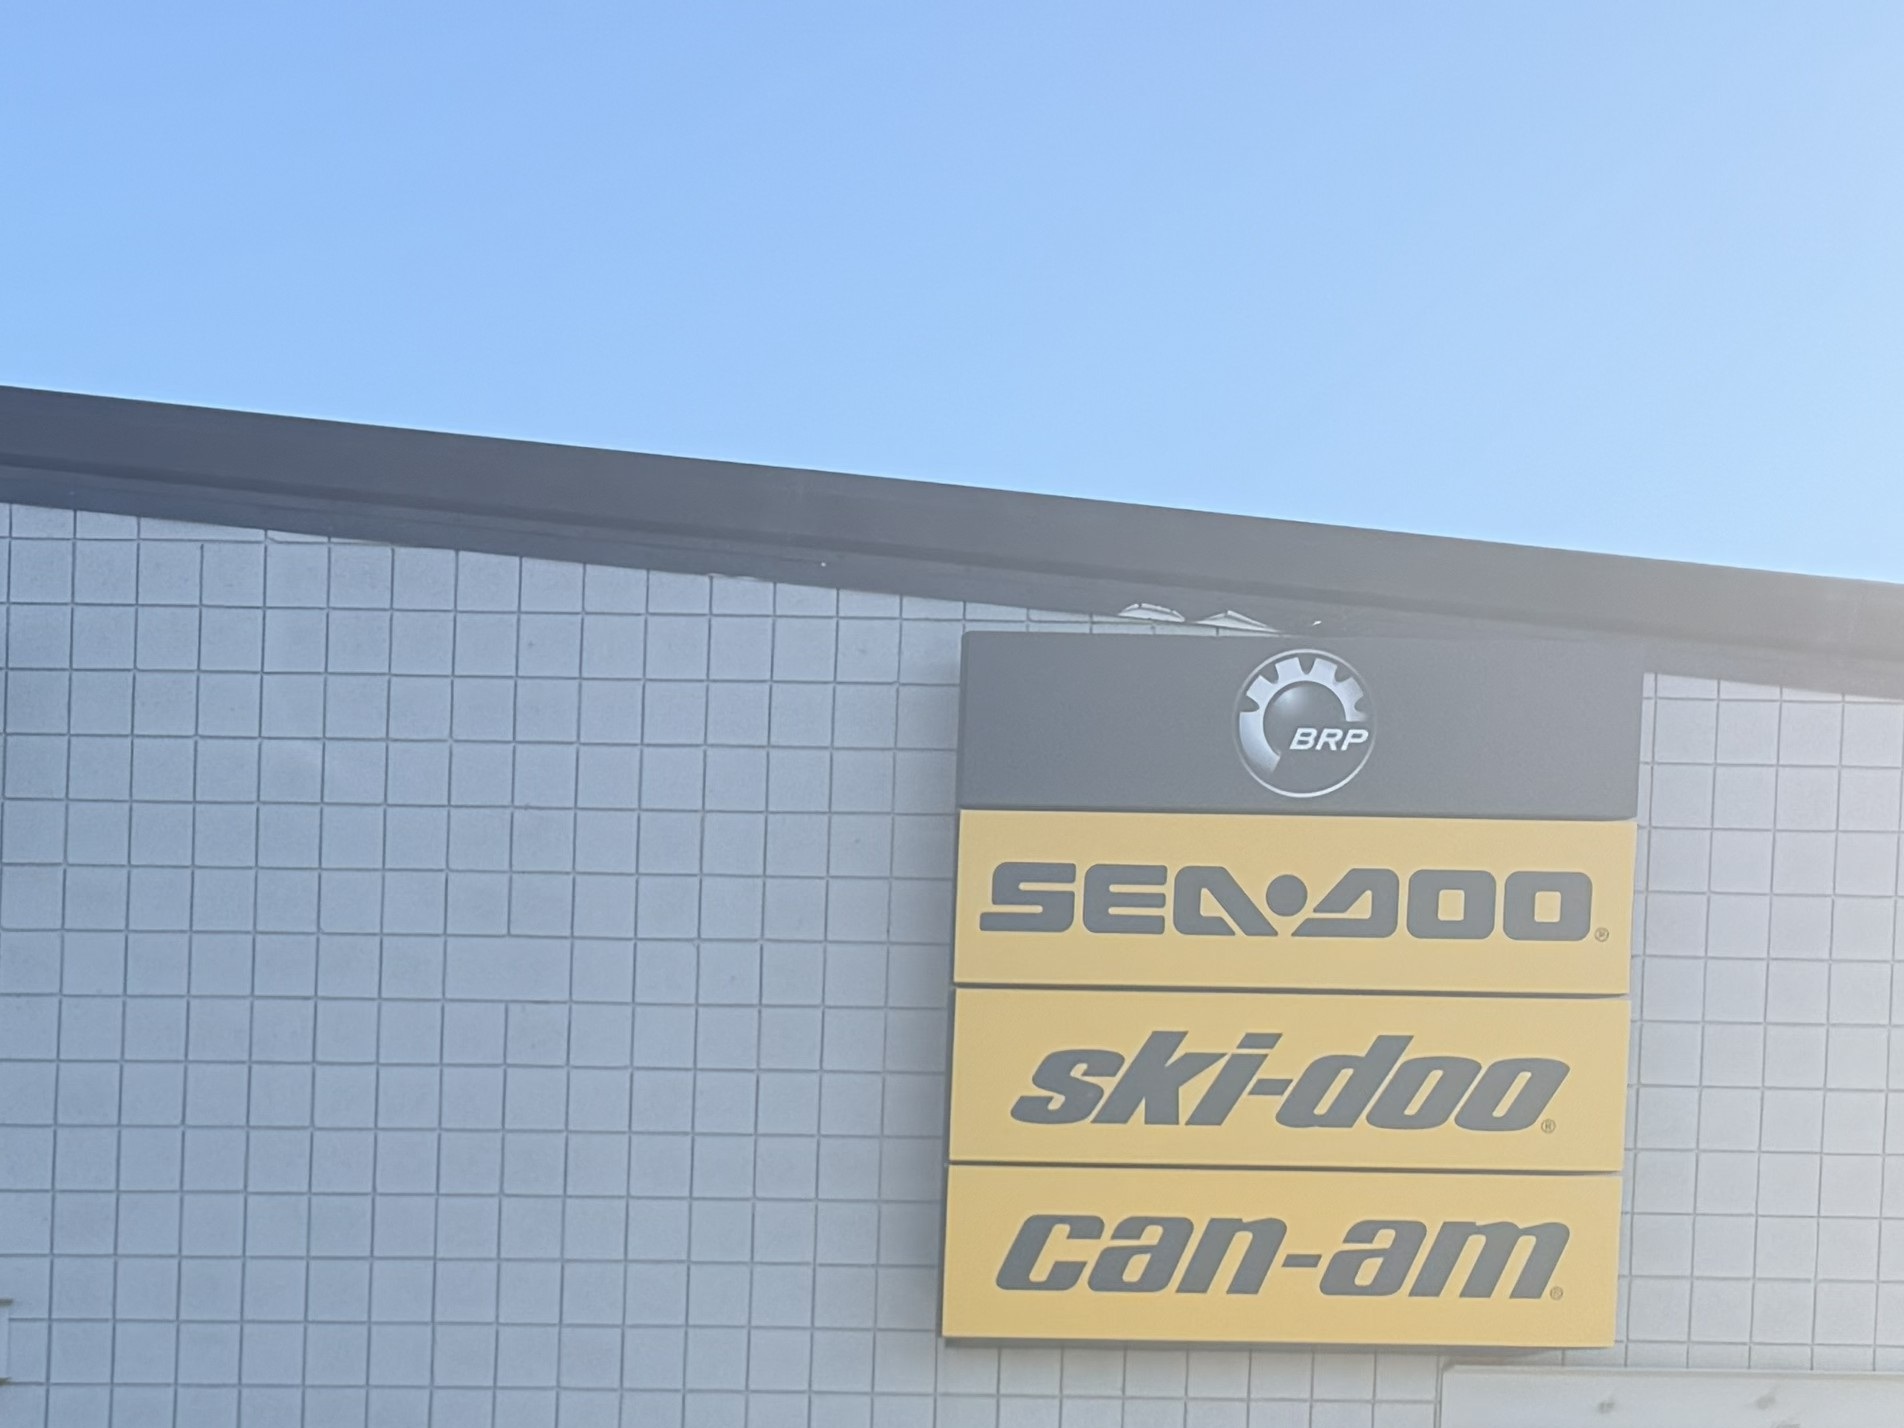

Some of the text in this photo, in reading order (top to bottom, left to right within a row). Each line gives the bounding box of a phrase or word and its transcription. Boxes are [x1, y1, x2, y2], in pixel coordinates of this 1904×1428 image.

[1289, 724, 1369, 753] BRP
[1010, 1031, 1569, 1132] ski-doo
[995, 1213, 1570, 1299] can-am
